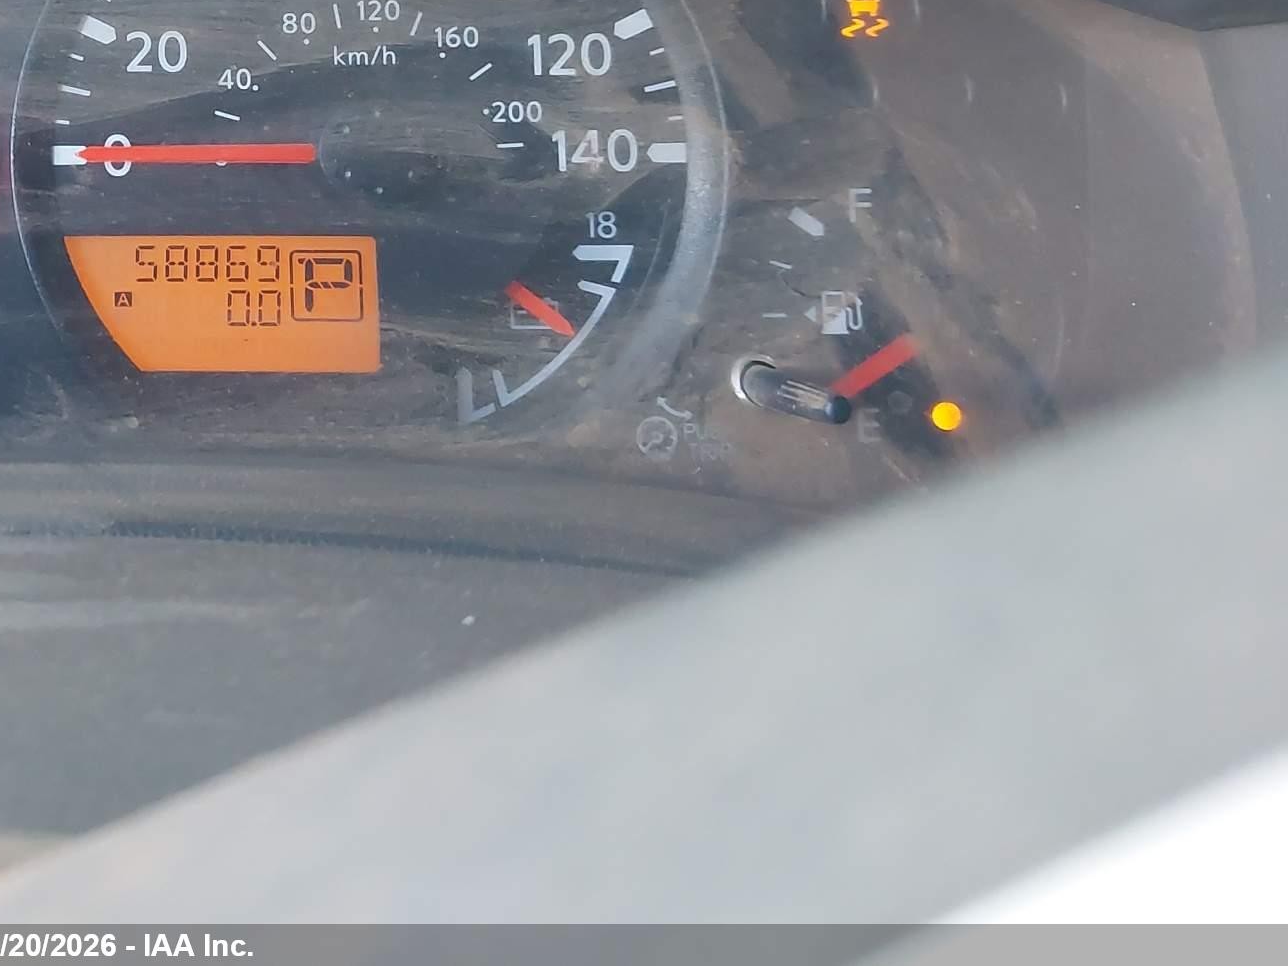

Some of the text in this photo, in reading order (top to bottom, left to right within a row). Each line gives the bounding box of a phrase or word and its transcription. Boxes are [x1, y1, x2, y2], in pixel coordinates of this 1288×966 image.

[282, 13, 316, 33] 80
[357, 1, 400, 20] 120
[126, 31, 188, 72] 20
[436, 27, 479, 48] 160
[333, 45, 397, 66] km/h
[528, 34, 612, 76] 120
[218, 68, 251, 90] 40
[492, 101, 542, 122] 200
[104, 134, 132, 177] 0
[553, 129, 638, 171] 140
[848, 188, 872, 222] F
[588, 212, 617, 237] 18
[136, 245, 280, 282] 58869
[304, 258, 352, 312] P
[227, 290, 281, 326] 0.0
